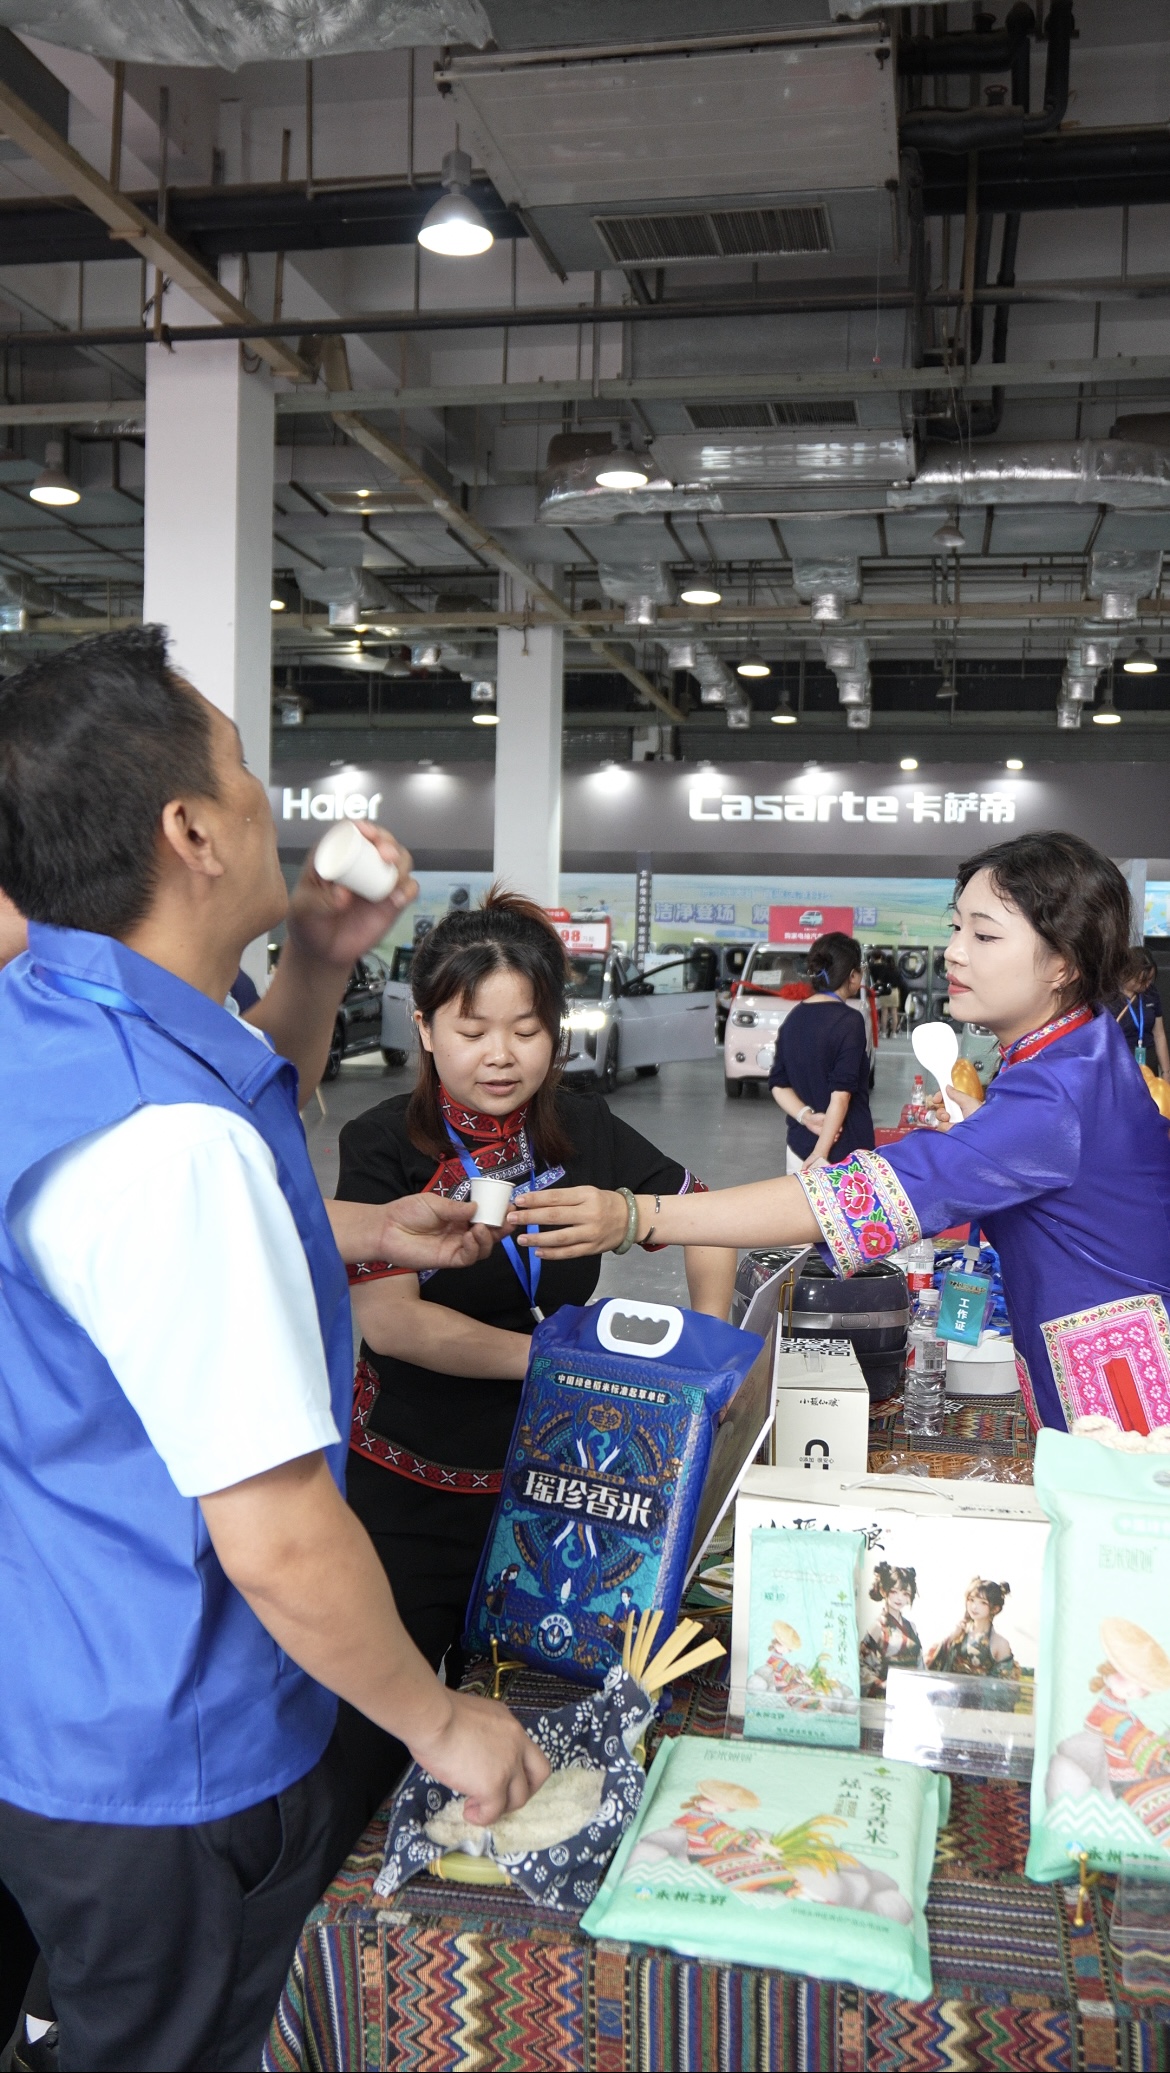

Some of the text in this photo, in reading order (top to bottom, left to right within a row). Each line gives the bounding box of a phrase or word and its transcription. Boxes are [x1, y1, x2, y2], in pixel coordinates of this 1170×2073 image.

[282, 787, 383, 821] Haier
[689, 788, 1016, 824] Casarte 卡萨帝
[954, 1297, 971, 1332] 工作证
[557, 1373, 667, 1404] 中国绿色稻米标准起草单位
[522, 1469, 653, 1529] 瑶珍香米
